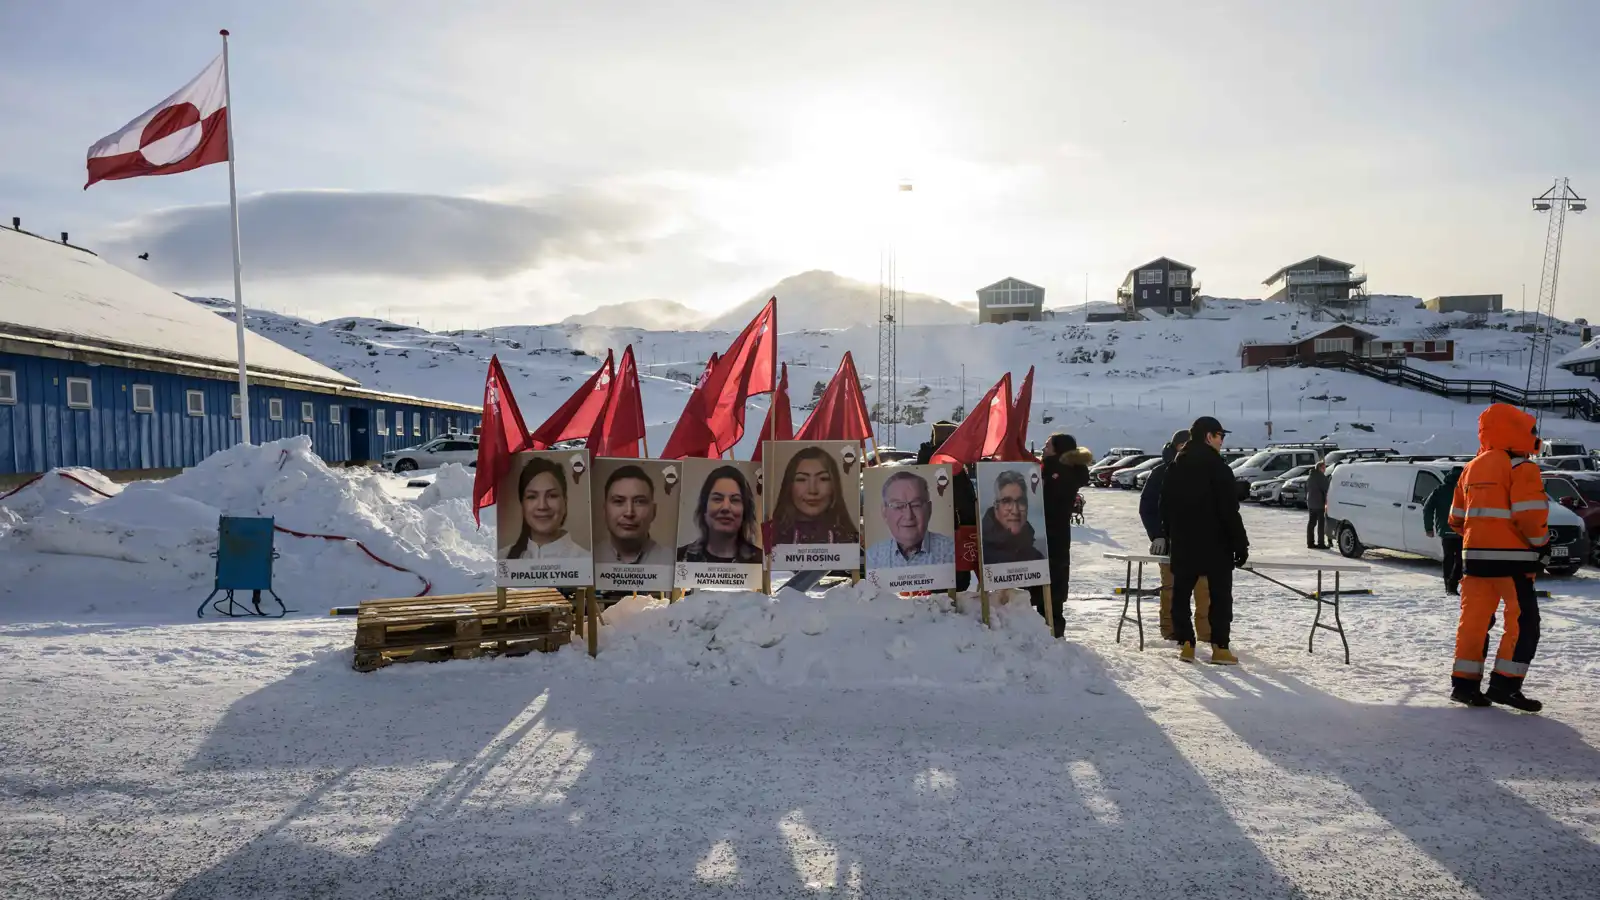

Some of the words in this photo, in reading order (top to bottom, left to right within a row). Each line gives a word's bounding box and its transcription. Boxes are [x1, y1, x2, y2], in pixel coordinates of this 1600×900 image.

[785, 554, 804, 562] NIVI
[806, 554, 841, 562] ROSING
[510, 571, 549, 580] PIPALUK
[550, 570, 579, 579] LYNGE
[600, 572, 658, 580] AQQALUKKULUK
[717, 572, 749, 580] HJELHOLT
[993, 573, 1024, 583] KALISTAT
[1024, 572, 1042, 580] LUND
[889, 580, 913, 588] KUUPIK
[913, 578, 935, 586] KLEIST
